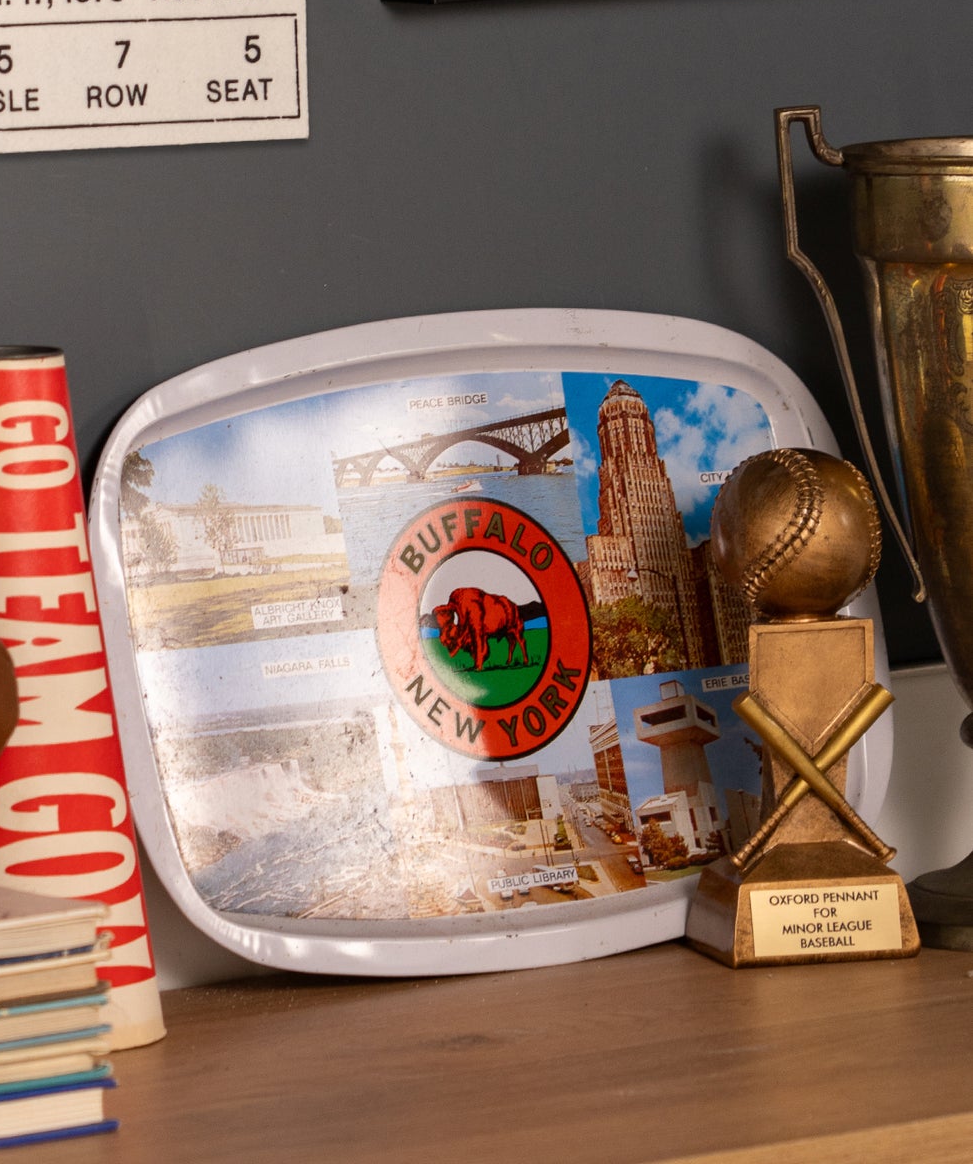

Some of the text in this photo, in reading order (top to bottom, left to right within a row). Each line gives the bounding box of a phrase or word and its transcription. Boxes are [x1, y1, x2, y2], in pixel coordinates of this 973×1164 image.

[114, 40, 131, 69] 7
[244, 35, 260, 64] 5
[86, 83, 149, 109] ROW
[206, 78, 273, 103] SEAT
[409, 393, 487, 410] PEACE BRIDGE
[700, 472, 723, 483] CITY
[399, 508, 554, 575] BUFFALO
[253, 598, 341, 616] ALBRIGHT KNOX
[262, 610, 335, 626] ART GALLERY
[264, 656, 351, 675] NIAGARA FALLS
[705, 677, 727, 689] ERIE
[405, 658, 581, 747] NEW YORK
[490, 868, 576, 890] PUBLIC LIBRARY
[769, 890, 879, 906] OXFORD PENNANT
[813, 907, 837, 918] FOR
[782, 919, 873, 935] MINOR LEAGUE
[800, 936, 855, 949] BASEBALL
